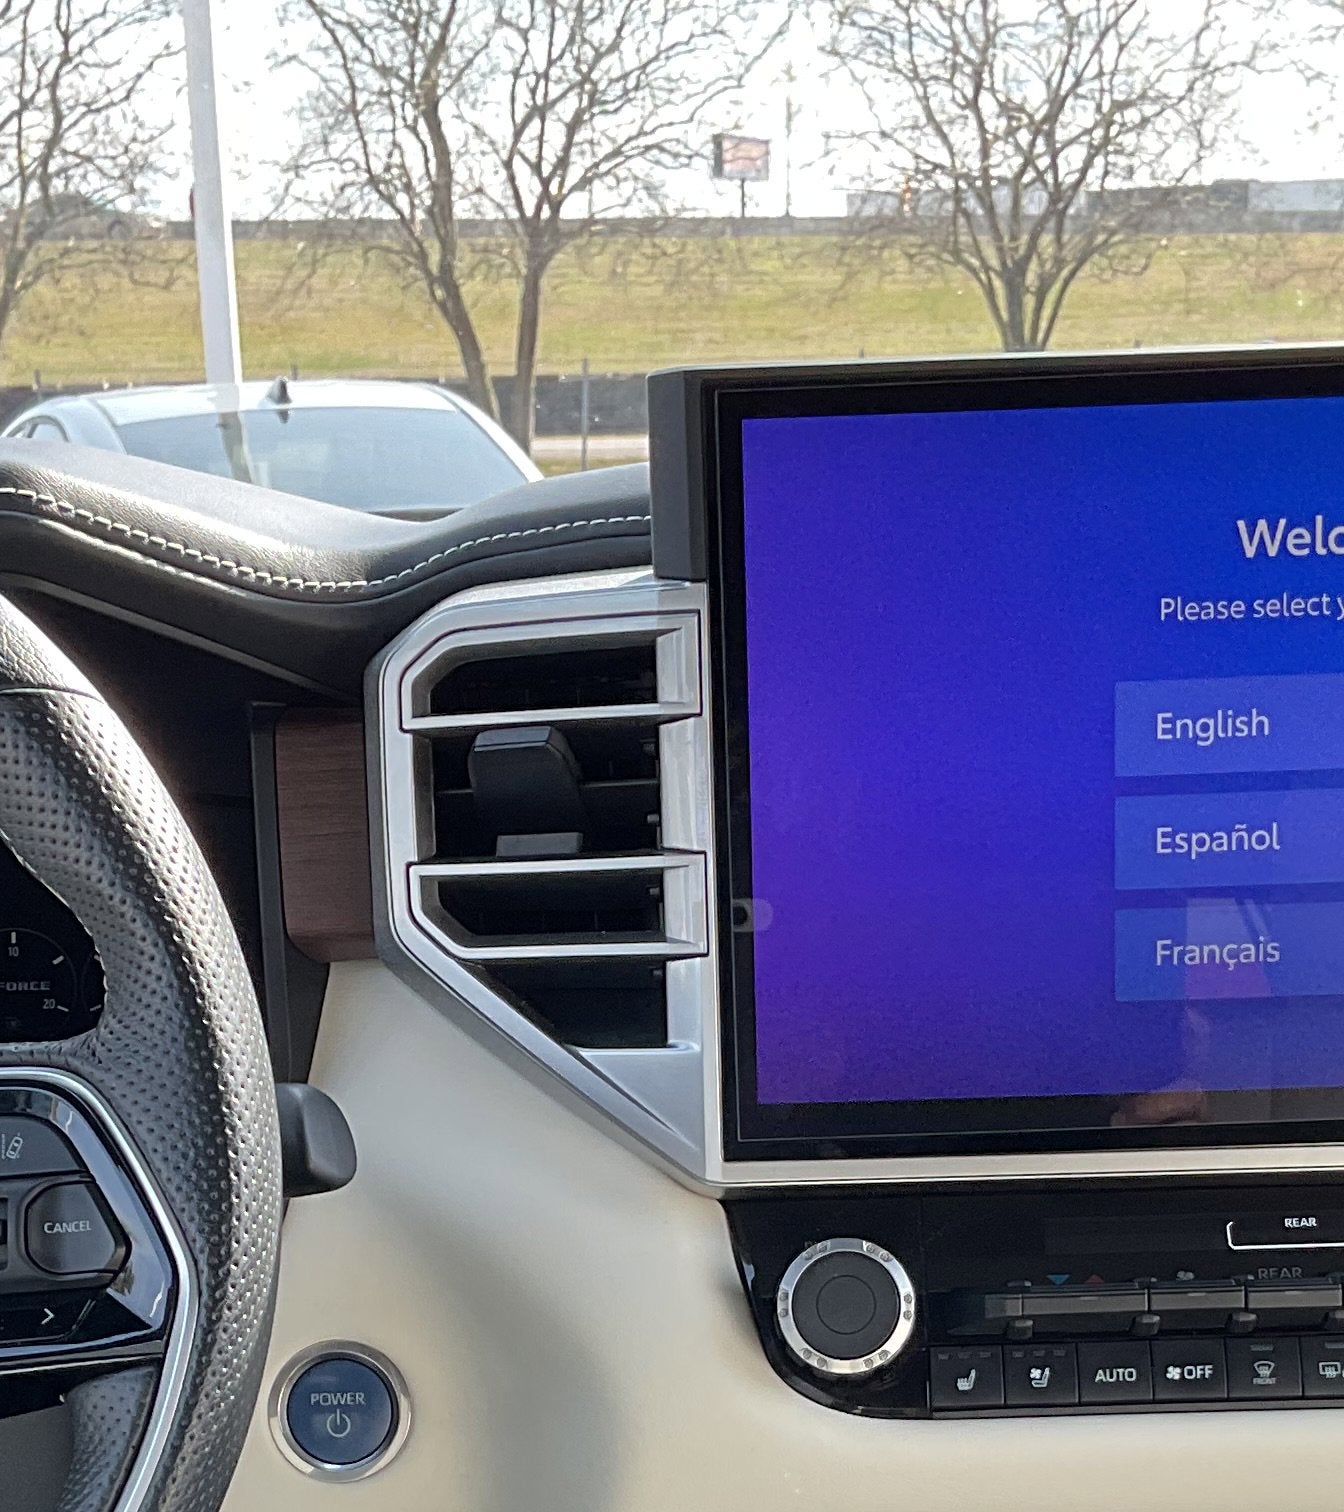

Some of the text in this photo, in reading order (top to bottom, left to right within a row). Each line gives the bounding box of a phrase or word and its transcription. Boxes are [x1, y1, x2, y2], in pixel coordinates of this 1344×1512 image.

[1159, 597, 1246, 622] Please
[1252, 592, 1331, 618] select
[1156, 708, 1271, 747] English
[1156, 822, 1281, 860] Español
[7, 946, 20, 958] 10
[1156, 935, 1281, 971] Français
[42, 999, 56, 1010] 20
[43, 1219, 93, 1234] CANCEL
[1284, 1216, 1318, 1229] REAR
[1257, 1266, 1303, 1280] REAR
[1094, 1367, 1137, 1383] AUTO
[1183, 1365, 1214, 1380] OFF
[310, 1391, 367, 1406] POWER
